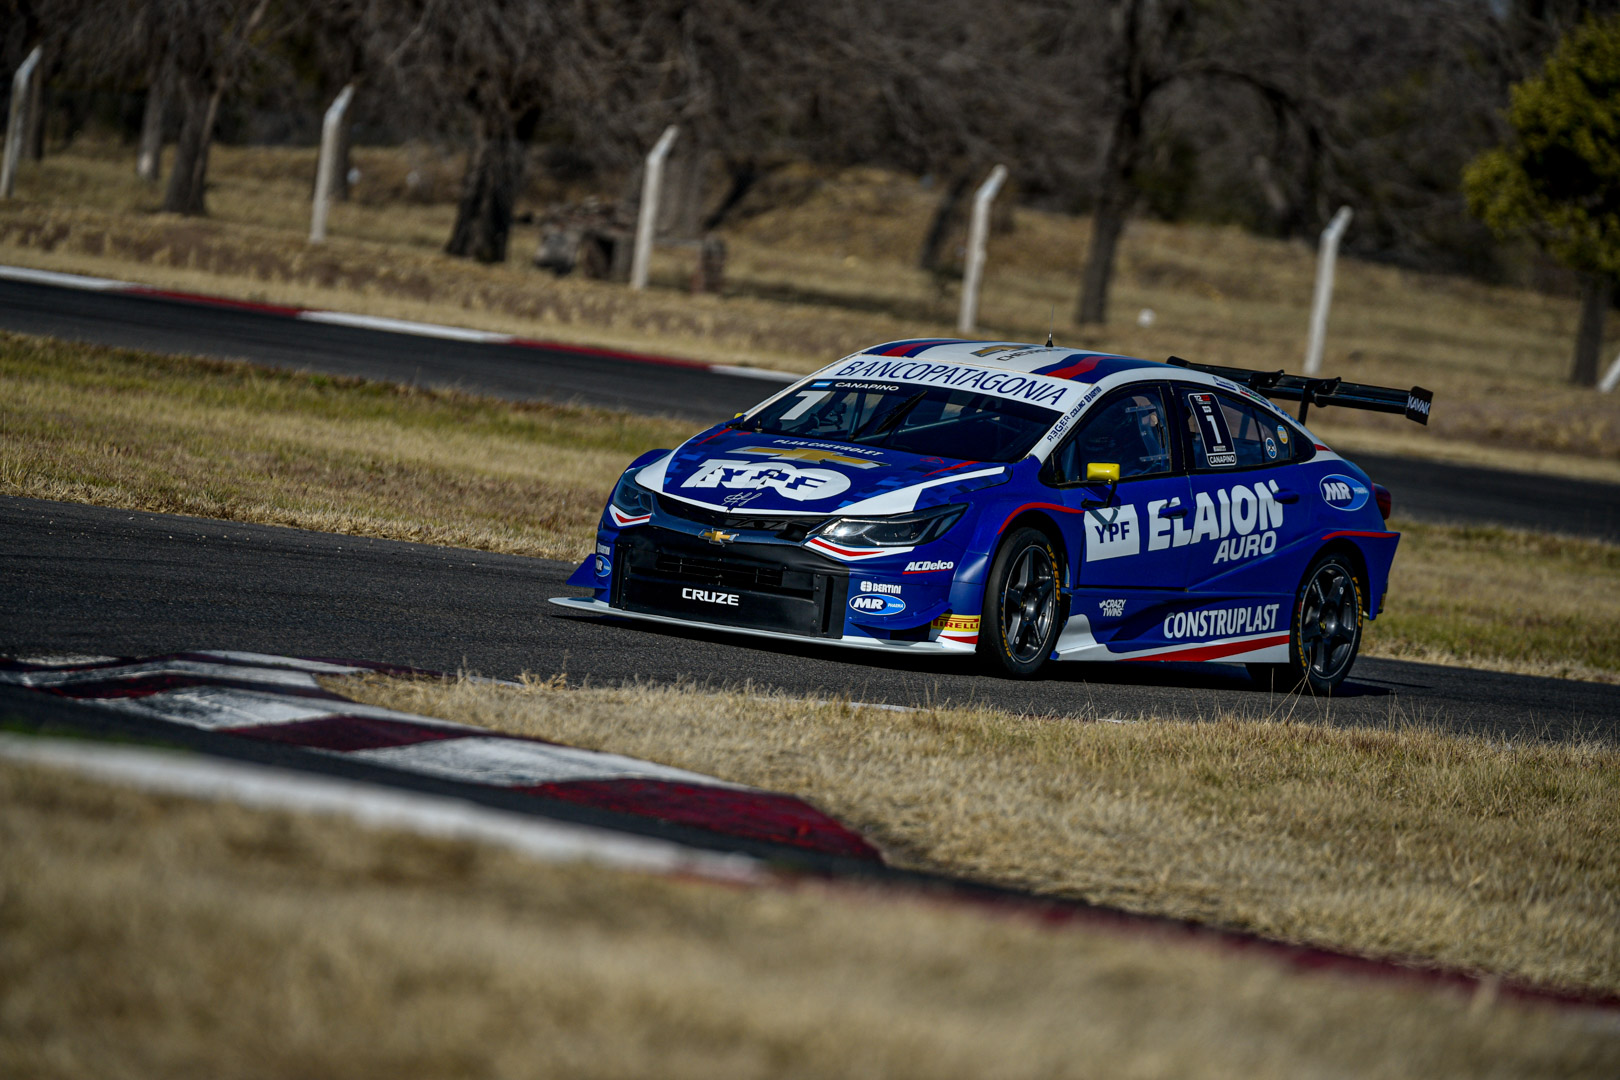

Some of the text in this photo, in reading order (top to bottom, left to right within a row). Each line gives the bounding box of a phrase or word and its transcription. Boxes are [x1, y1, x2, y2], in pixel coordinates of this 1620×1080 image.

[834, 381, 900, 392] CANAPINO
[835, 360, 1069, 406] BANCOPATAGONIA
[779, 390, 831, 420] 1
[1407, 395, 1431, 416] KAVAK
[1205, 415, 1223, 444] 1
[772, 439, 885, 457] PLAN CHEVROLET
[1209, 455, 1236, 464] CANAPINO
[1322, 482, 1353, 501] MR
[1147, 479, 1284, 552] ELAION
[1094, 520, 1131, 545] YPF
[1212, 530, 1277, 565] AURO
[903, 560, 955, 573] ACDelco
[681, 587, 740, 607] CRUZE
[872, 583, 902, 595] BERTINI
[853, 597, 884, 610] MR
[1102, 607, 1124, 617] TWINS
[1105, 599, 1128, 609] CRAZY
[1163, 603, 1280, 639] CONSTRUPLAST
